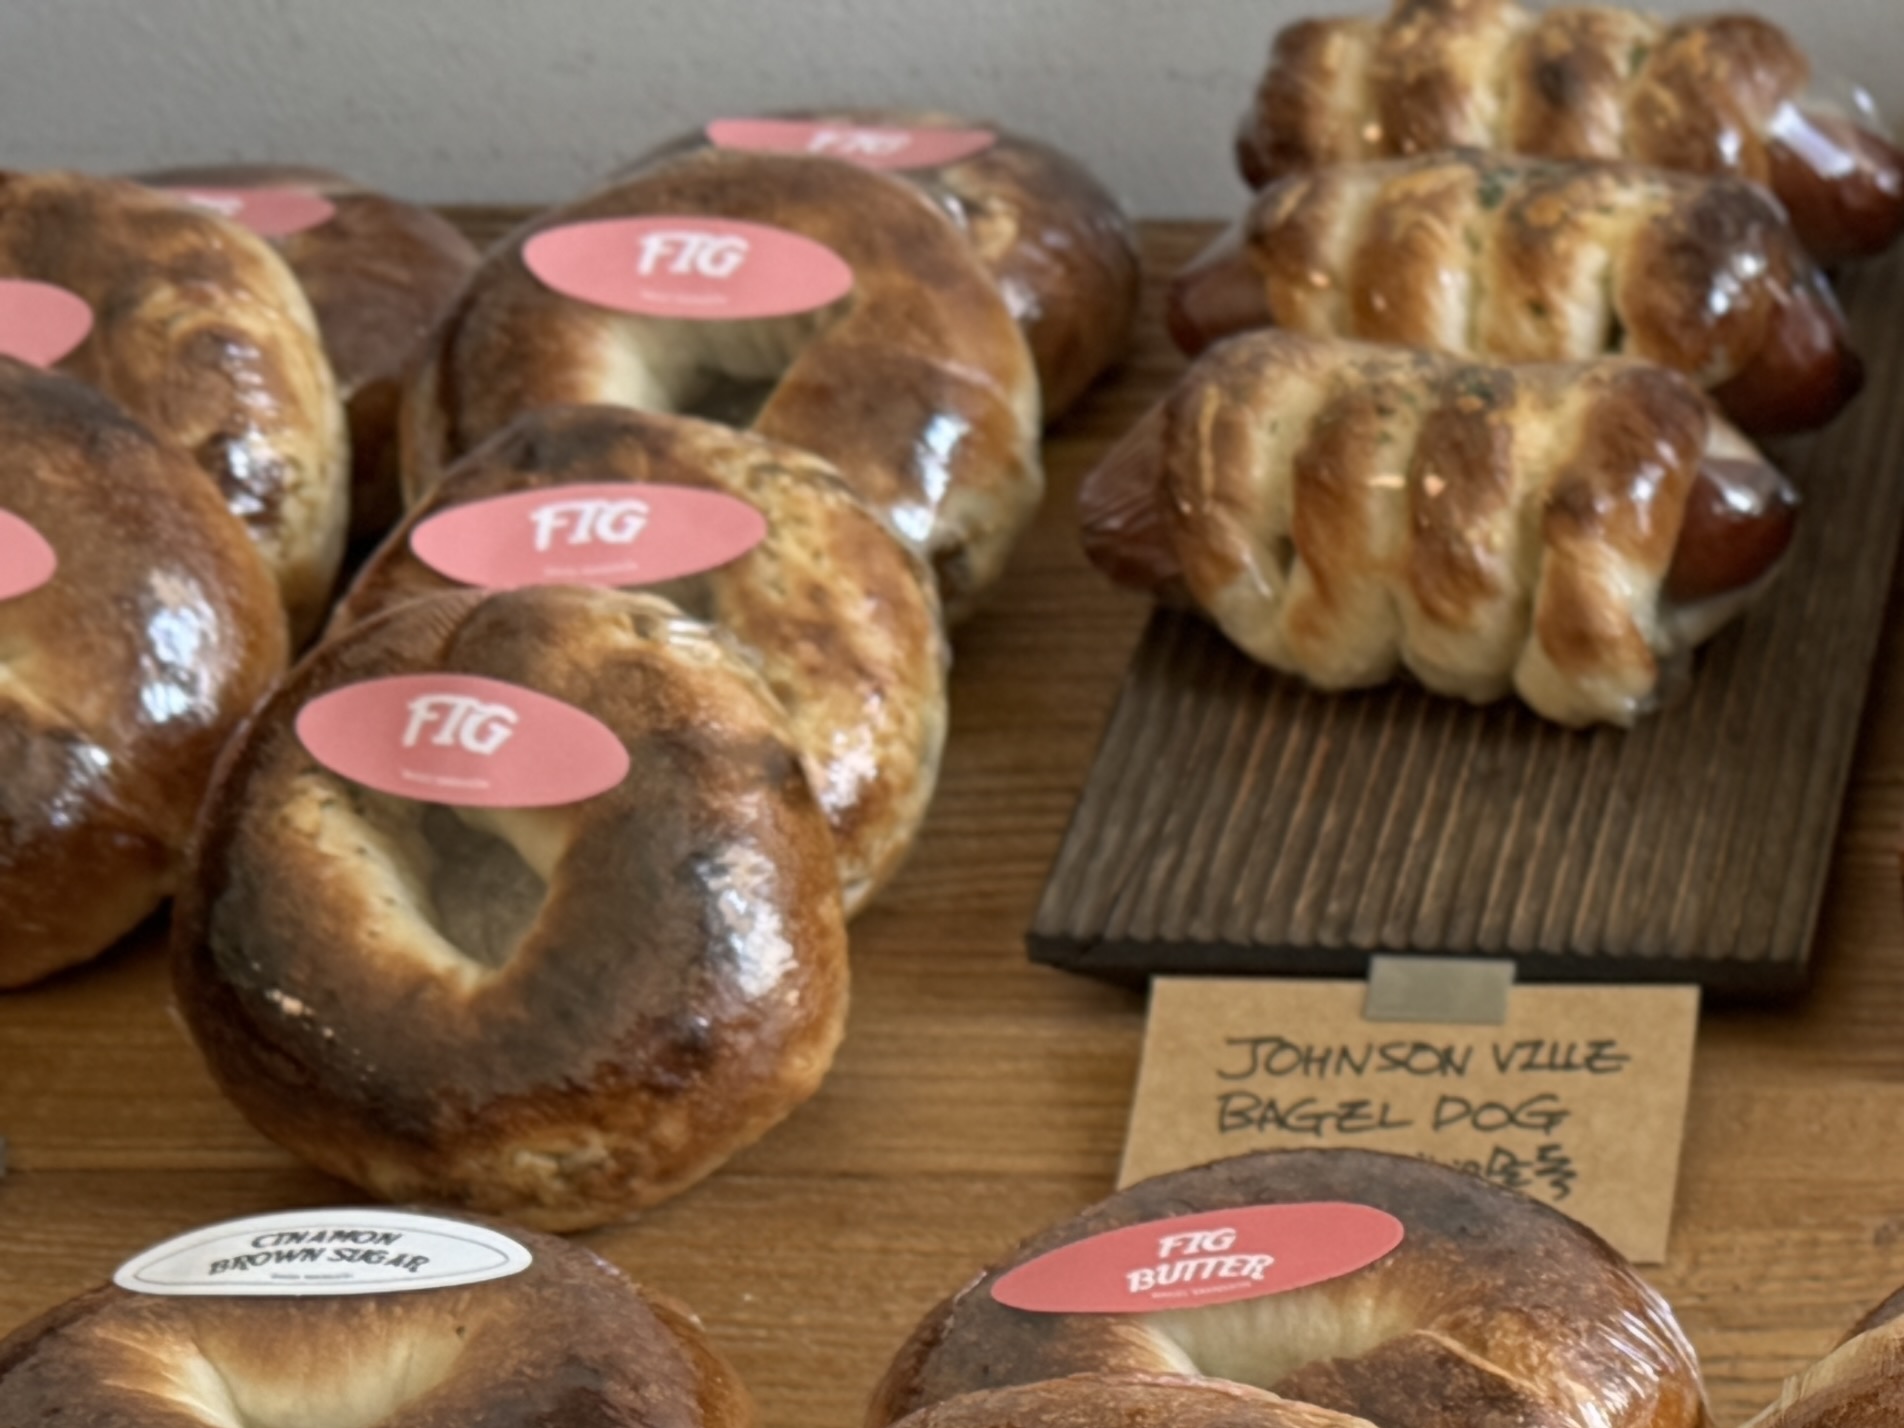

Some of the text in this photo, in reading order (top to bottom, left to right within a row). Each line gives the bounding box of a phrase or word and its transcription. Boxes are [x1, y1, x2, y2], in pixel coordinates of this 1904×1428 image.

[636, 230, 749, 279] FIG
[528, 497, 651, 553] FIG
[402, 693, 520, 755] FIG
[1215, 1034, 1473, 1082] JOHNSON
[1217, 1091, 1571, 1137] BAGEL DOG
[208, 1247, 430, 1276] BROWN SUGAR
[251, 1230, 403, 1249] CINAMON
[1158, 1227, 1237, 1259] FIG
[1126, 1254, 1275, 1293] BUTTER
